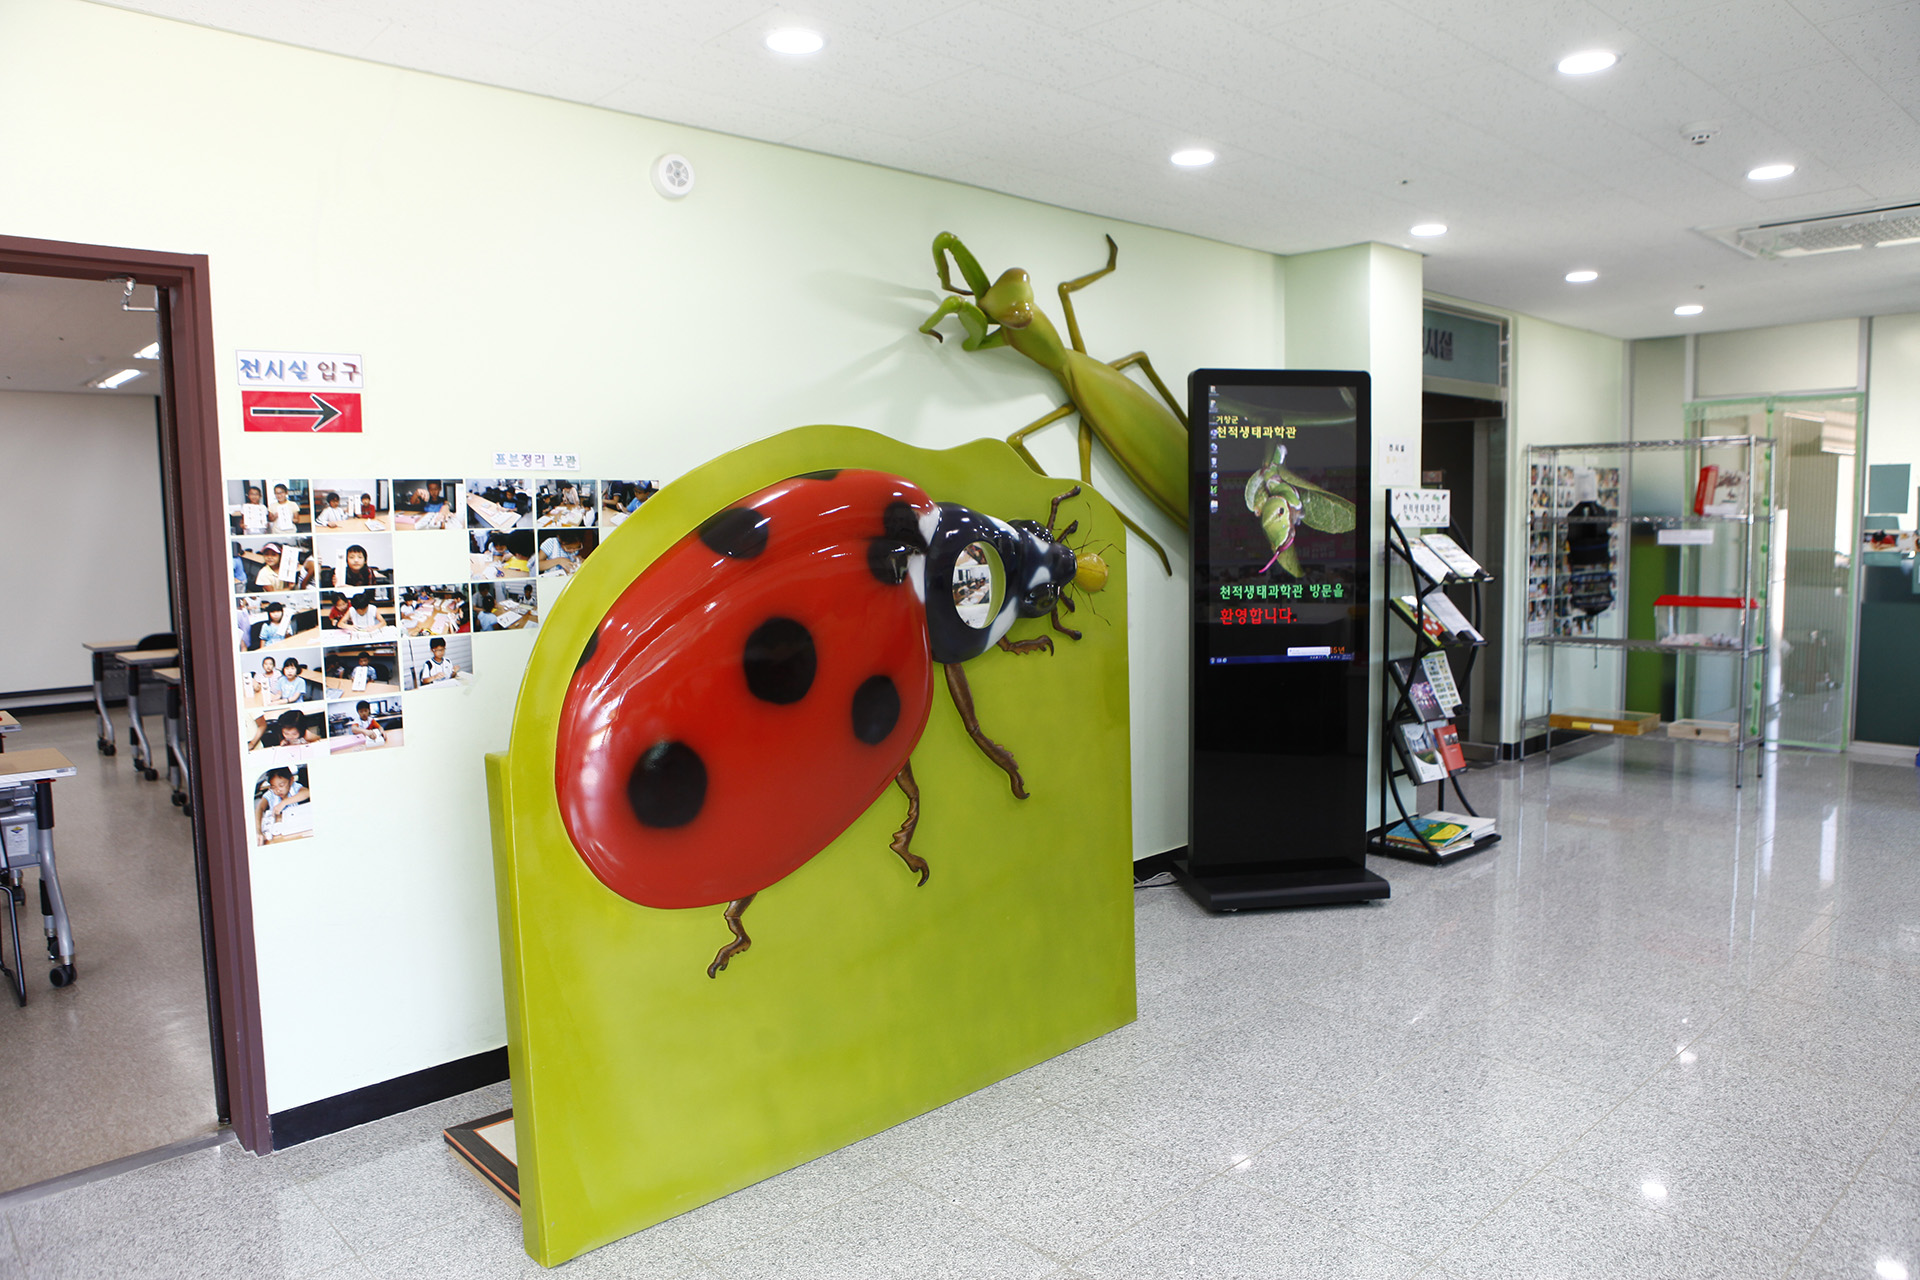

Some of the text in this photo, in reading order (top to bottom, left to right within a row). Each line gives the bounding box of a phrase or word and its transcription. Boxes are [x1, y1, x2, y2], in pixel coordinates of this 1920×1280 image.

[1423, 326, 1453, 361] 시실
[239, 358, 361, 382] 전시실 입구
[1216, 415, 1239, 425] 거창군
[1217, 426, 1297, 439] 천적생태과학관
[495, 453, 545, 468] 표본정리
[1220, 583, 1344, 600] 천적생태과학관 방문을
[1220, 607, 1297, 625] 환영합니다.
